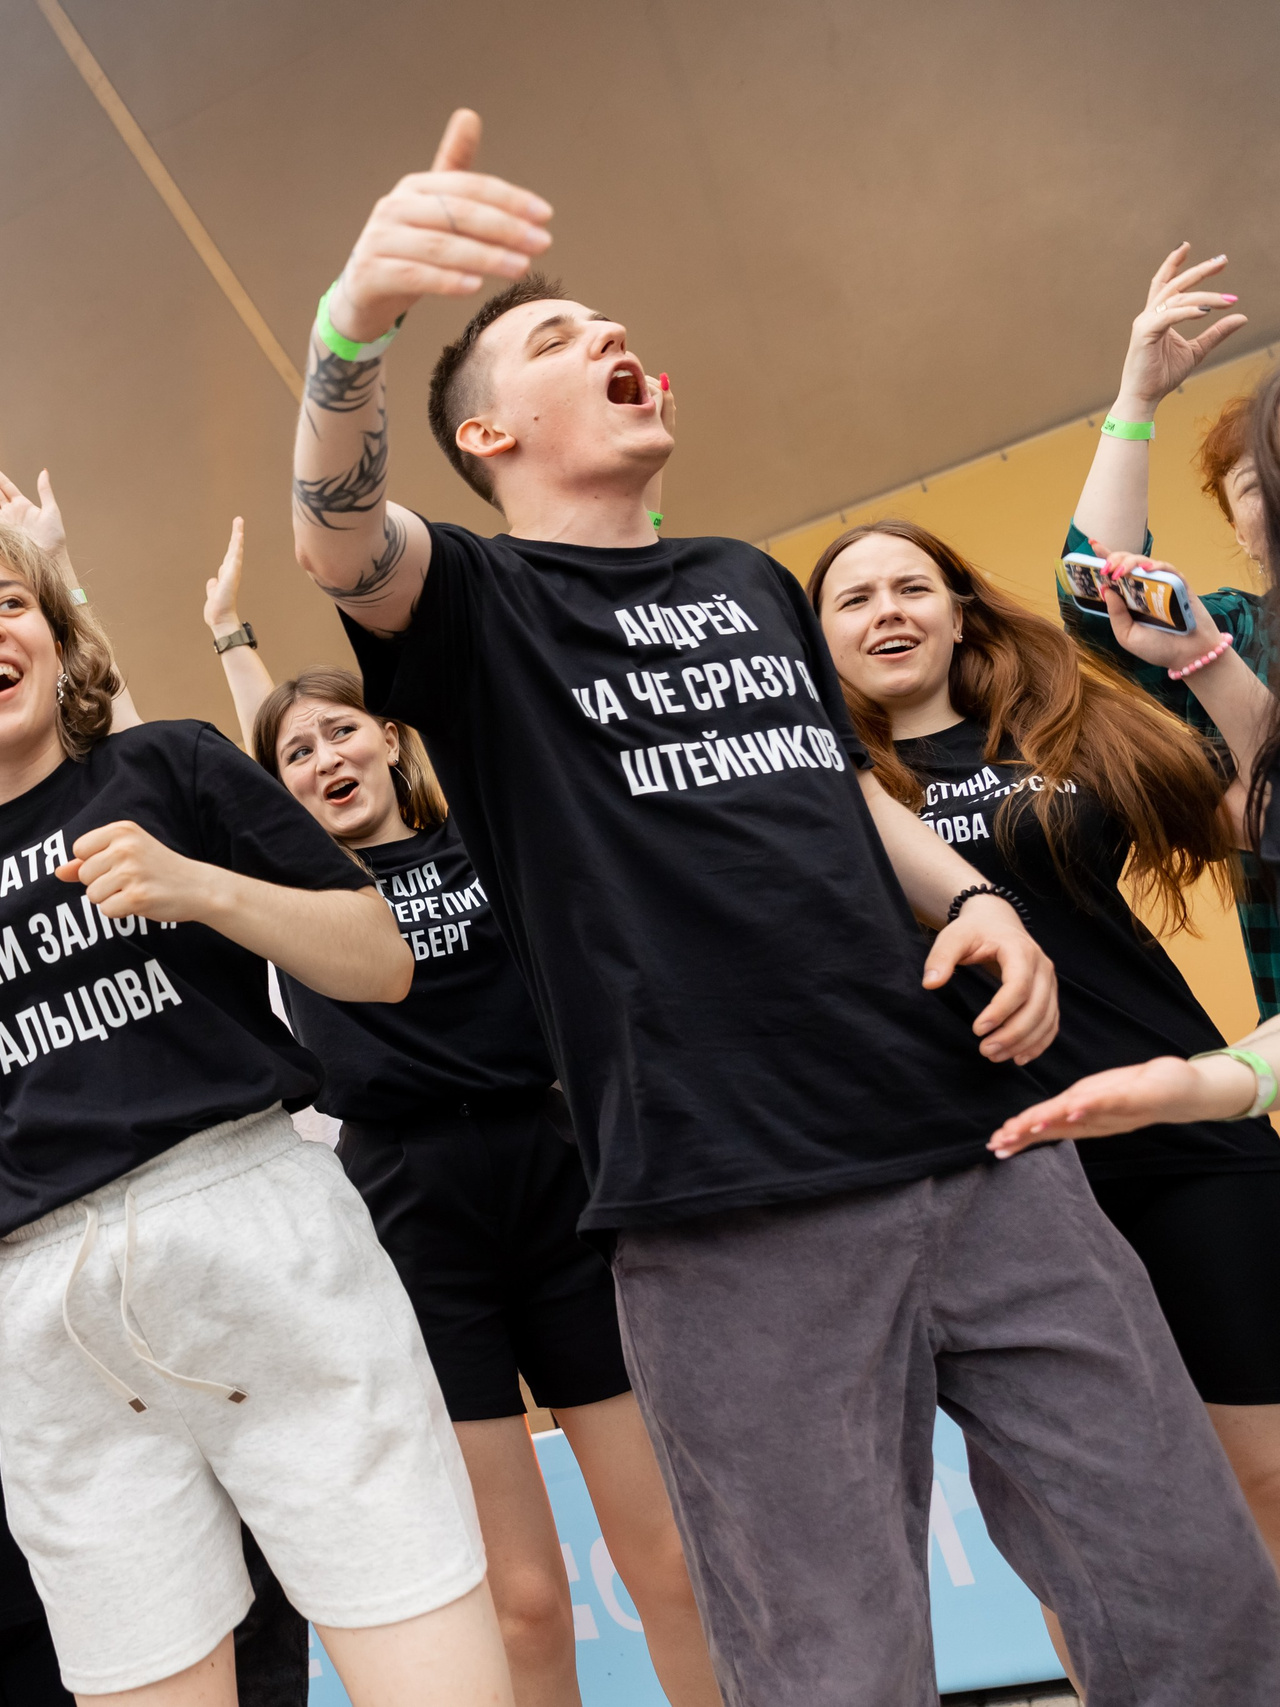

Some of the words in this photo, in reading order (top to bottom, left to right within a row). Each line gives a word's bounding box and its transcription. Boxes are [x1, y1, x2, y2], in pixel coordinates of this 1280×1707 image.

[614, 594, 759, 650] АНДРЕЙ
[626, 671, 686, 715] ЧЕ
[681, 655, 797, 711] СРАЗУ
[620, 725, 845, 796] ШТЕЙНИКОВ
[921, 766, 1001, 806] СТИНА
[376, 861, 442, 898] ГАЛЯ
[28, 894, 177, 964] ЗАЛ
[400, 919, 472, 961] БЕРГ
